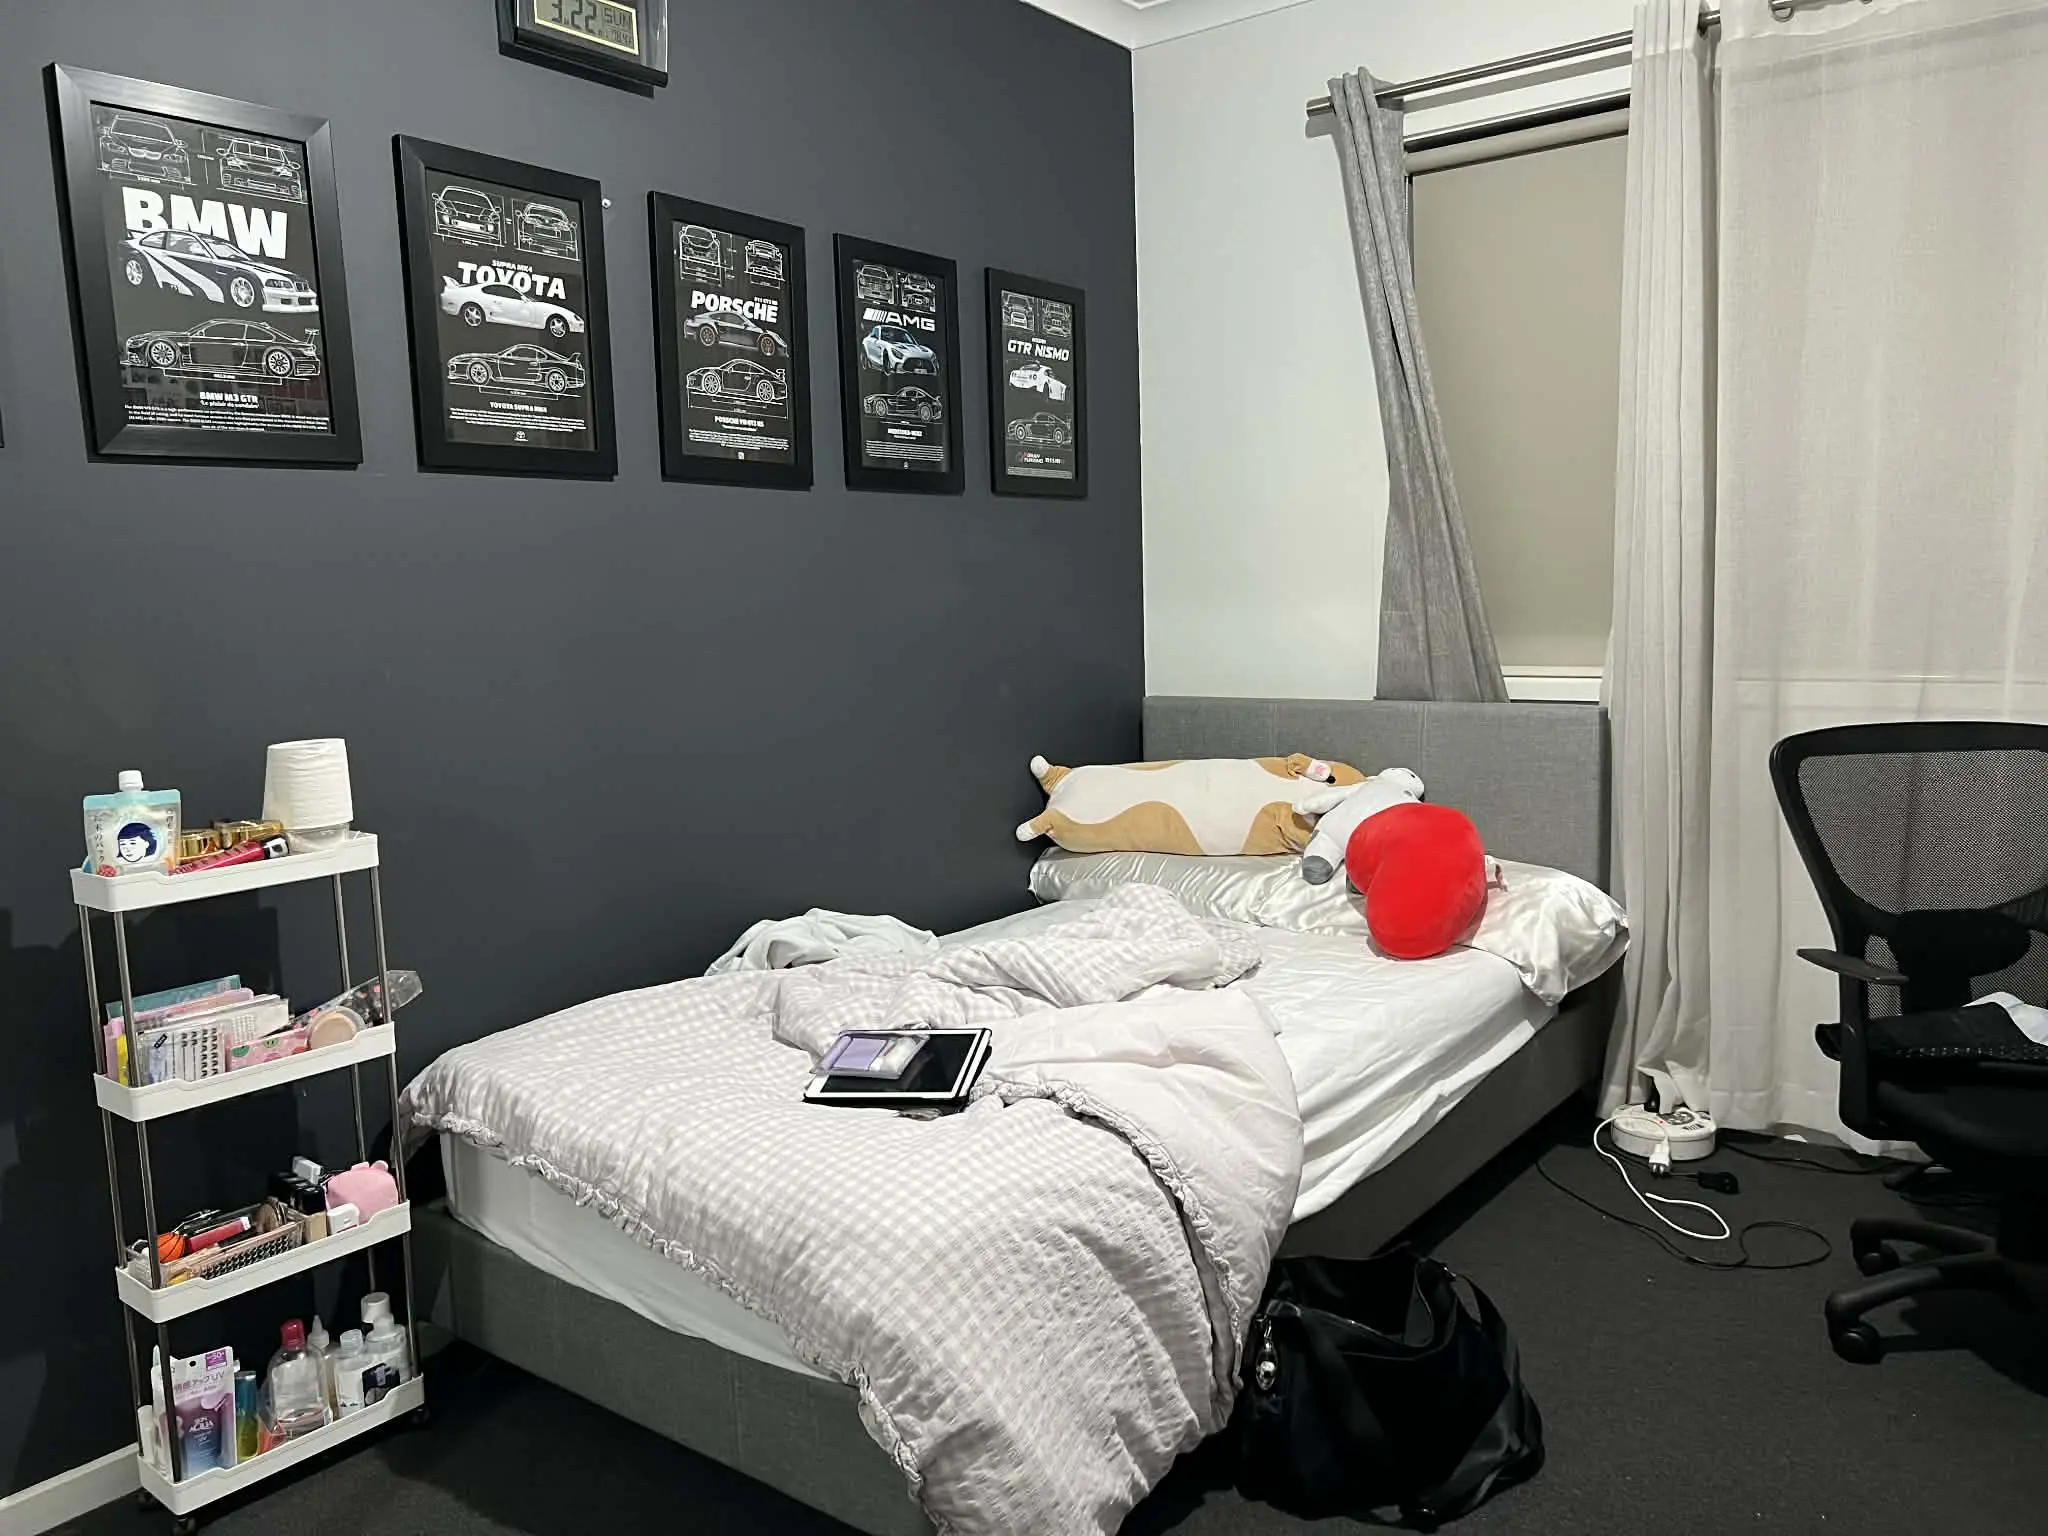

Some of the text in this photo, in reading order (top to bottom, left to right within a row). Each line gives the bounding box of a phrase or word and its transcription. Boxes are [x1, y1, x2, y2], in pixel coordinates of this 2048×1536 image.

[122, 187, 288, 260] BMW
[458, 261, 566, 299] TOYOTA
[690, 290, 778, 323] PORSCHE
[885, 312, 936, 331] AMG
[1008, 340, 1033, 355] GTR
[1035, 344, 1070, 361] NISMO
[200, 391, 259, 404] BMW M3 GTR
